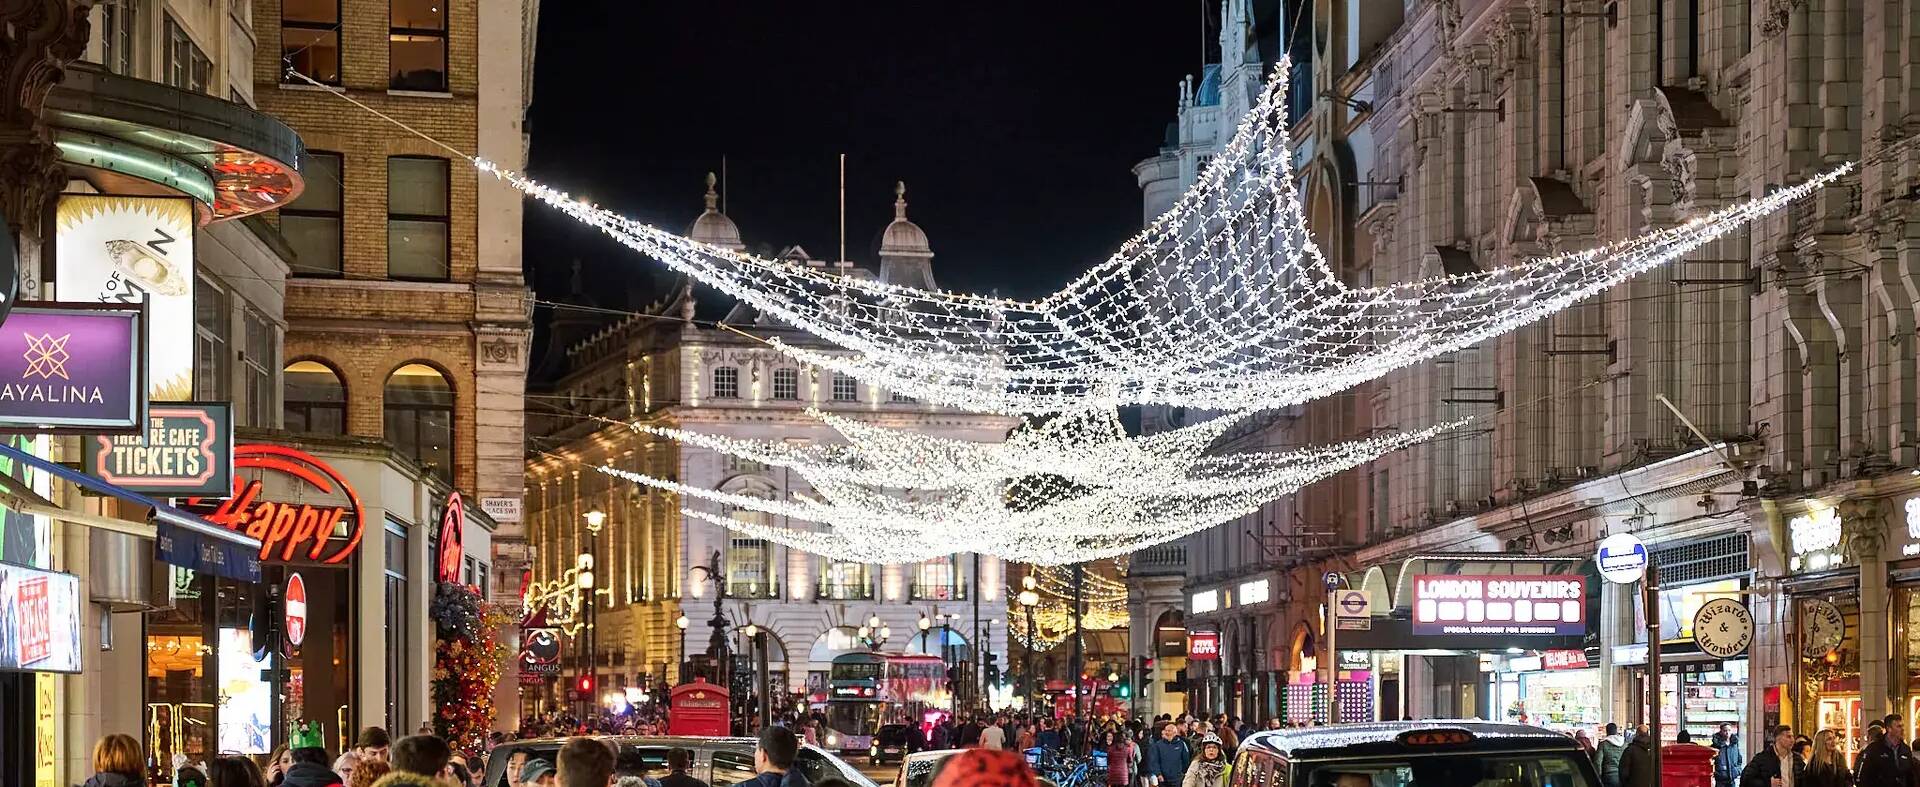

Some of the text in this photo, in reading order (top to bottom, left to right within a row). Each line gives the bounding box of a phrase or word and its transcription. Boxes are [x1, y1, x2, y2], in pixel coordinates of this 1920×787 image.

[0, 383, 104, 404] AYALINA
[150, 417, 164, 429] THE
[113, 428, 200, 446] THEARE CAFE
[113, 446, 200, 476] TICKETS
[204, 475, 345, 562] Happy
[1418, 579, 1582, 599] LONDON SOUVENIRS
[1699, 605, 1748, 624] Wizards
[1719, 621, 1729, 633] &
[1192, 646, 1217, 655] GUYS
[1193, 639, 1214, 648] FIVE
[1700, 632, 1748, 655] Wonders
[528, 664, 561, 672] ANGUS
